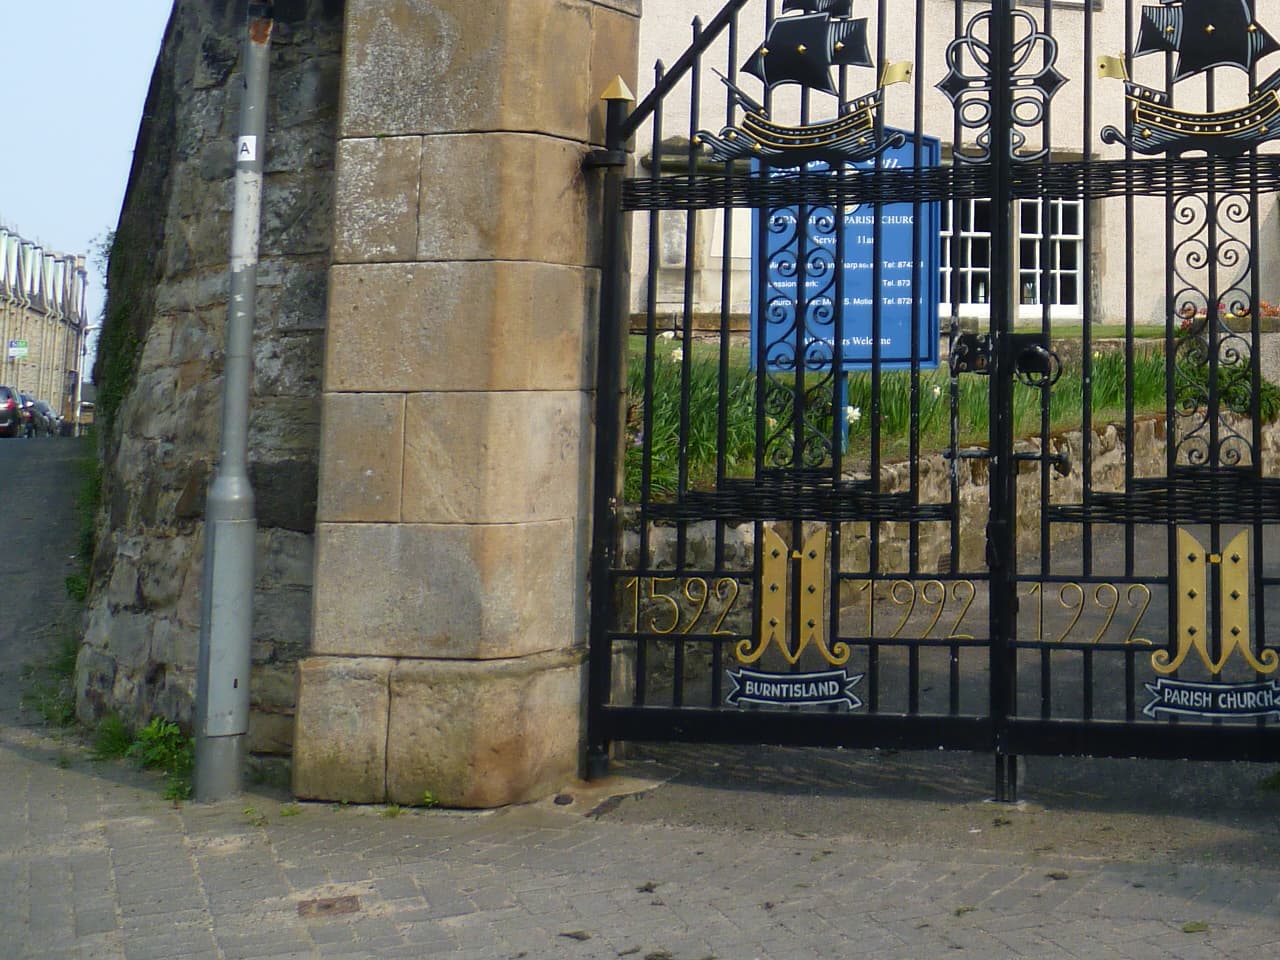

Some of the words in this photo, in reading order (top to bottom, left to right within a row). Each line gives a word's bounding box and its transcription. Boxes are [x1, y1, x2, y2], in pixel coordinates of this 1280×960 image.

[240, 142, 250, 155] A
[625, 577, 741, 635] 1592
[860, 579, 976, 640] 1992
[1028, 582, 1153, 646] 1992
[745, 680, 840, 698] BURNTISLAND
[1164, 688, 1211, 707] PARISH
[1218, 689, 1273, 709] CHURCH
